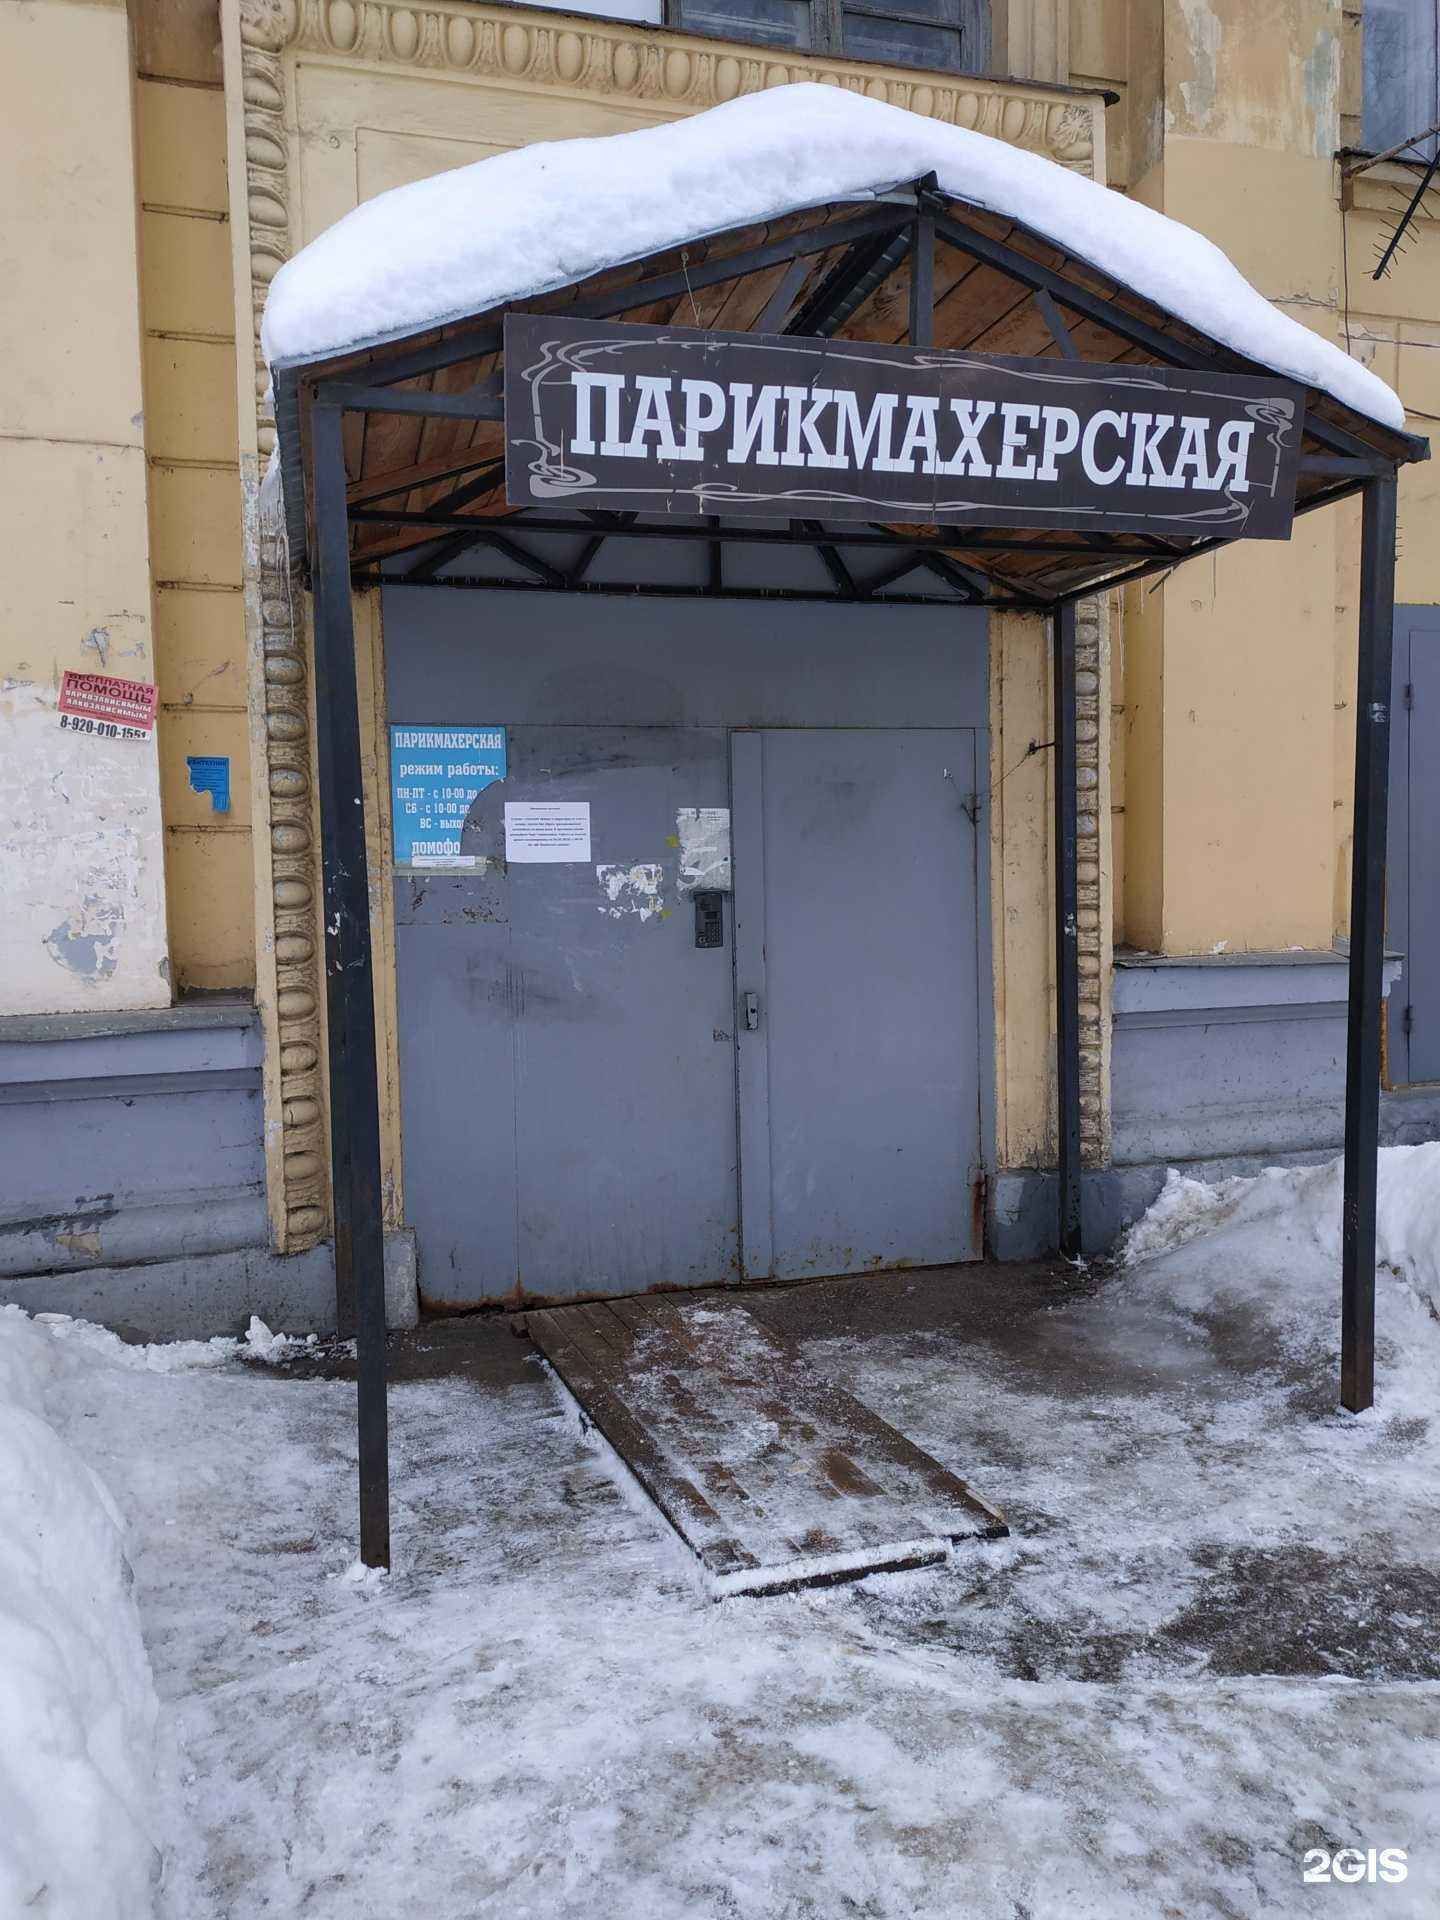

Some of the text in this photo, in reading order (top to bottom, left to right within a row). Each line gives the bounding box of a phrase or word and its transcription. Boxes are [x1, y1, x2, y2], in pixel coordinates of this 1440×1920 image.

[570, 370, 1256, 494] ПАРИКМАХЕРСКАЯ
[66, 678, 153, 705] ПОМОЩЬ
[395, 732, 502, 749] ПАРИКМАХЕРСКАЯ
[400, 762, 499, 778] режим работы:
[397, 788, 425, 799] ПН-ПТ
[442, 788, 465, 799] 10-00
[405, 803, 417, 814] СБ
[434, 803, 457, 814] 10-00
[420, 818, 432, 829] ВС
